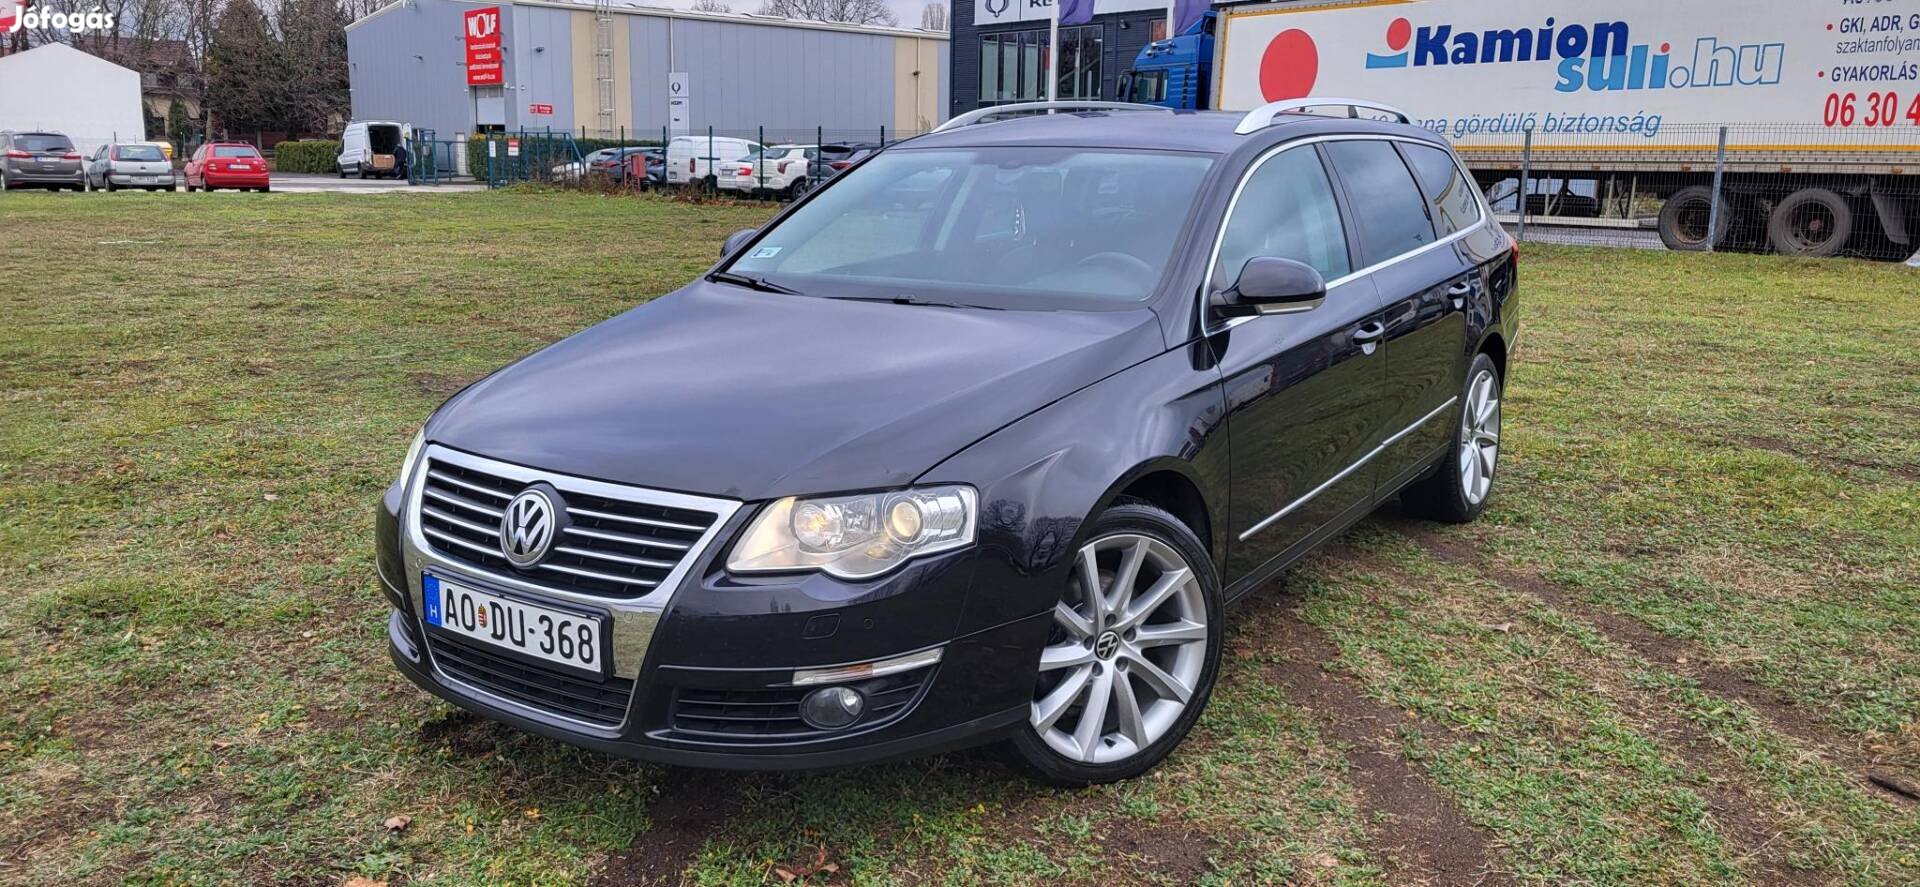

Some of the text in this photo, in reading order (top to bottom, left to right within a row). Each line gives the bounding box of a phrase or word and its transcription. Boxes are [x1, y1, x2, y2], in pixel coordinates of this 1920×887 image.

[467, 13, 497, 38] WOLF
[1840, 17, 1867, 35] GKI,
[1870, 15, 1904, 33] ADR,
[1413, 16, 1630, 66] Kamion
[1831, 61, 1918, 82] GYAKORLÁS
[1823, 92, 1857, 127] 06
[1864, 91, 1898, 127] 30
[1454, 112, 1537, 139] gördülő
[1542, 110, 1663, 137] biztonság
[489, 600, 594, 664] DU-368
